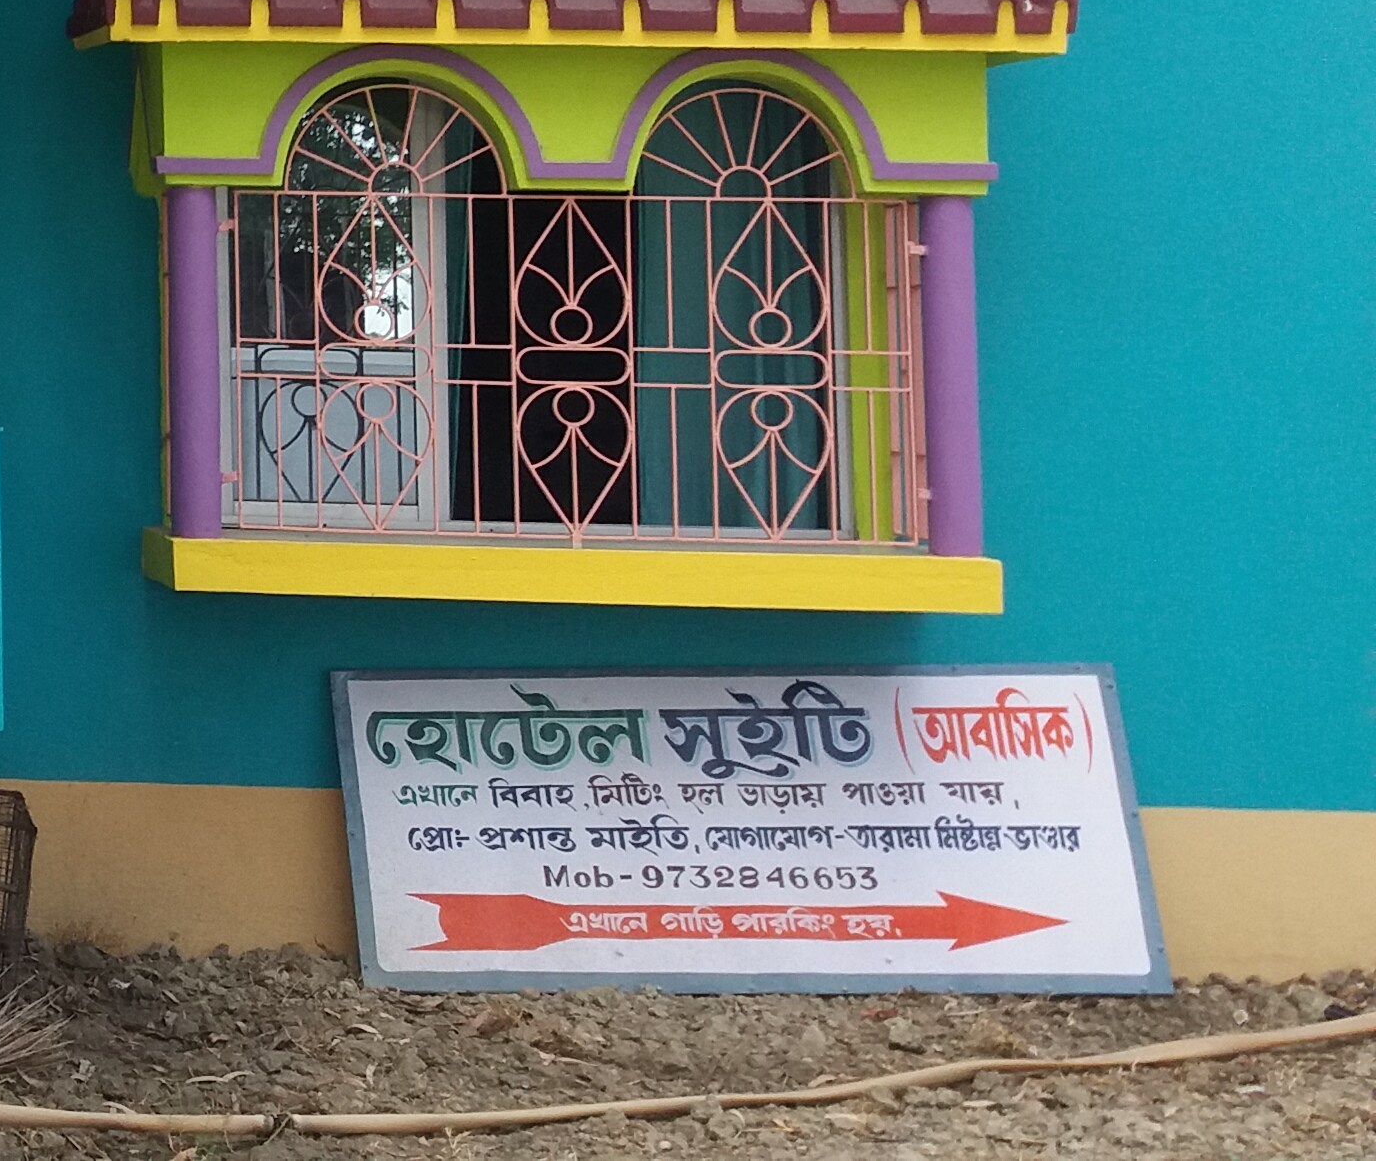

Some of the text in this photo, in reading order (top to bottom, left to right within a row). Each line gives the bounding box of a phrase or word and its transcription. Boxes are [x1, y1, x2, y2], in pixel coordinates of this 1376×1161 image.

[365, 678, 1093, 780] হোটেল সুইটি (আবাসিক)
[395, 784, 479, 807] এখানে
[678, 783, 725, 814] হল
[737, 783, 828, 815] ভাড়ায়
[841, 782, 926, 806] পাওয়া
[478, 826, 577, 853] প্রশান্ত
[559, 912, 649, 935] এখানে
[659, 906, 724, 940] গাড়ি
[731, 906, 837, 940] পারকিং
